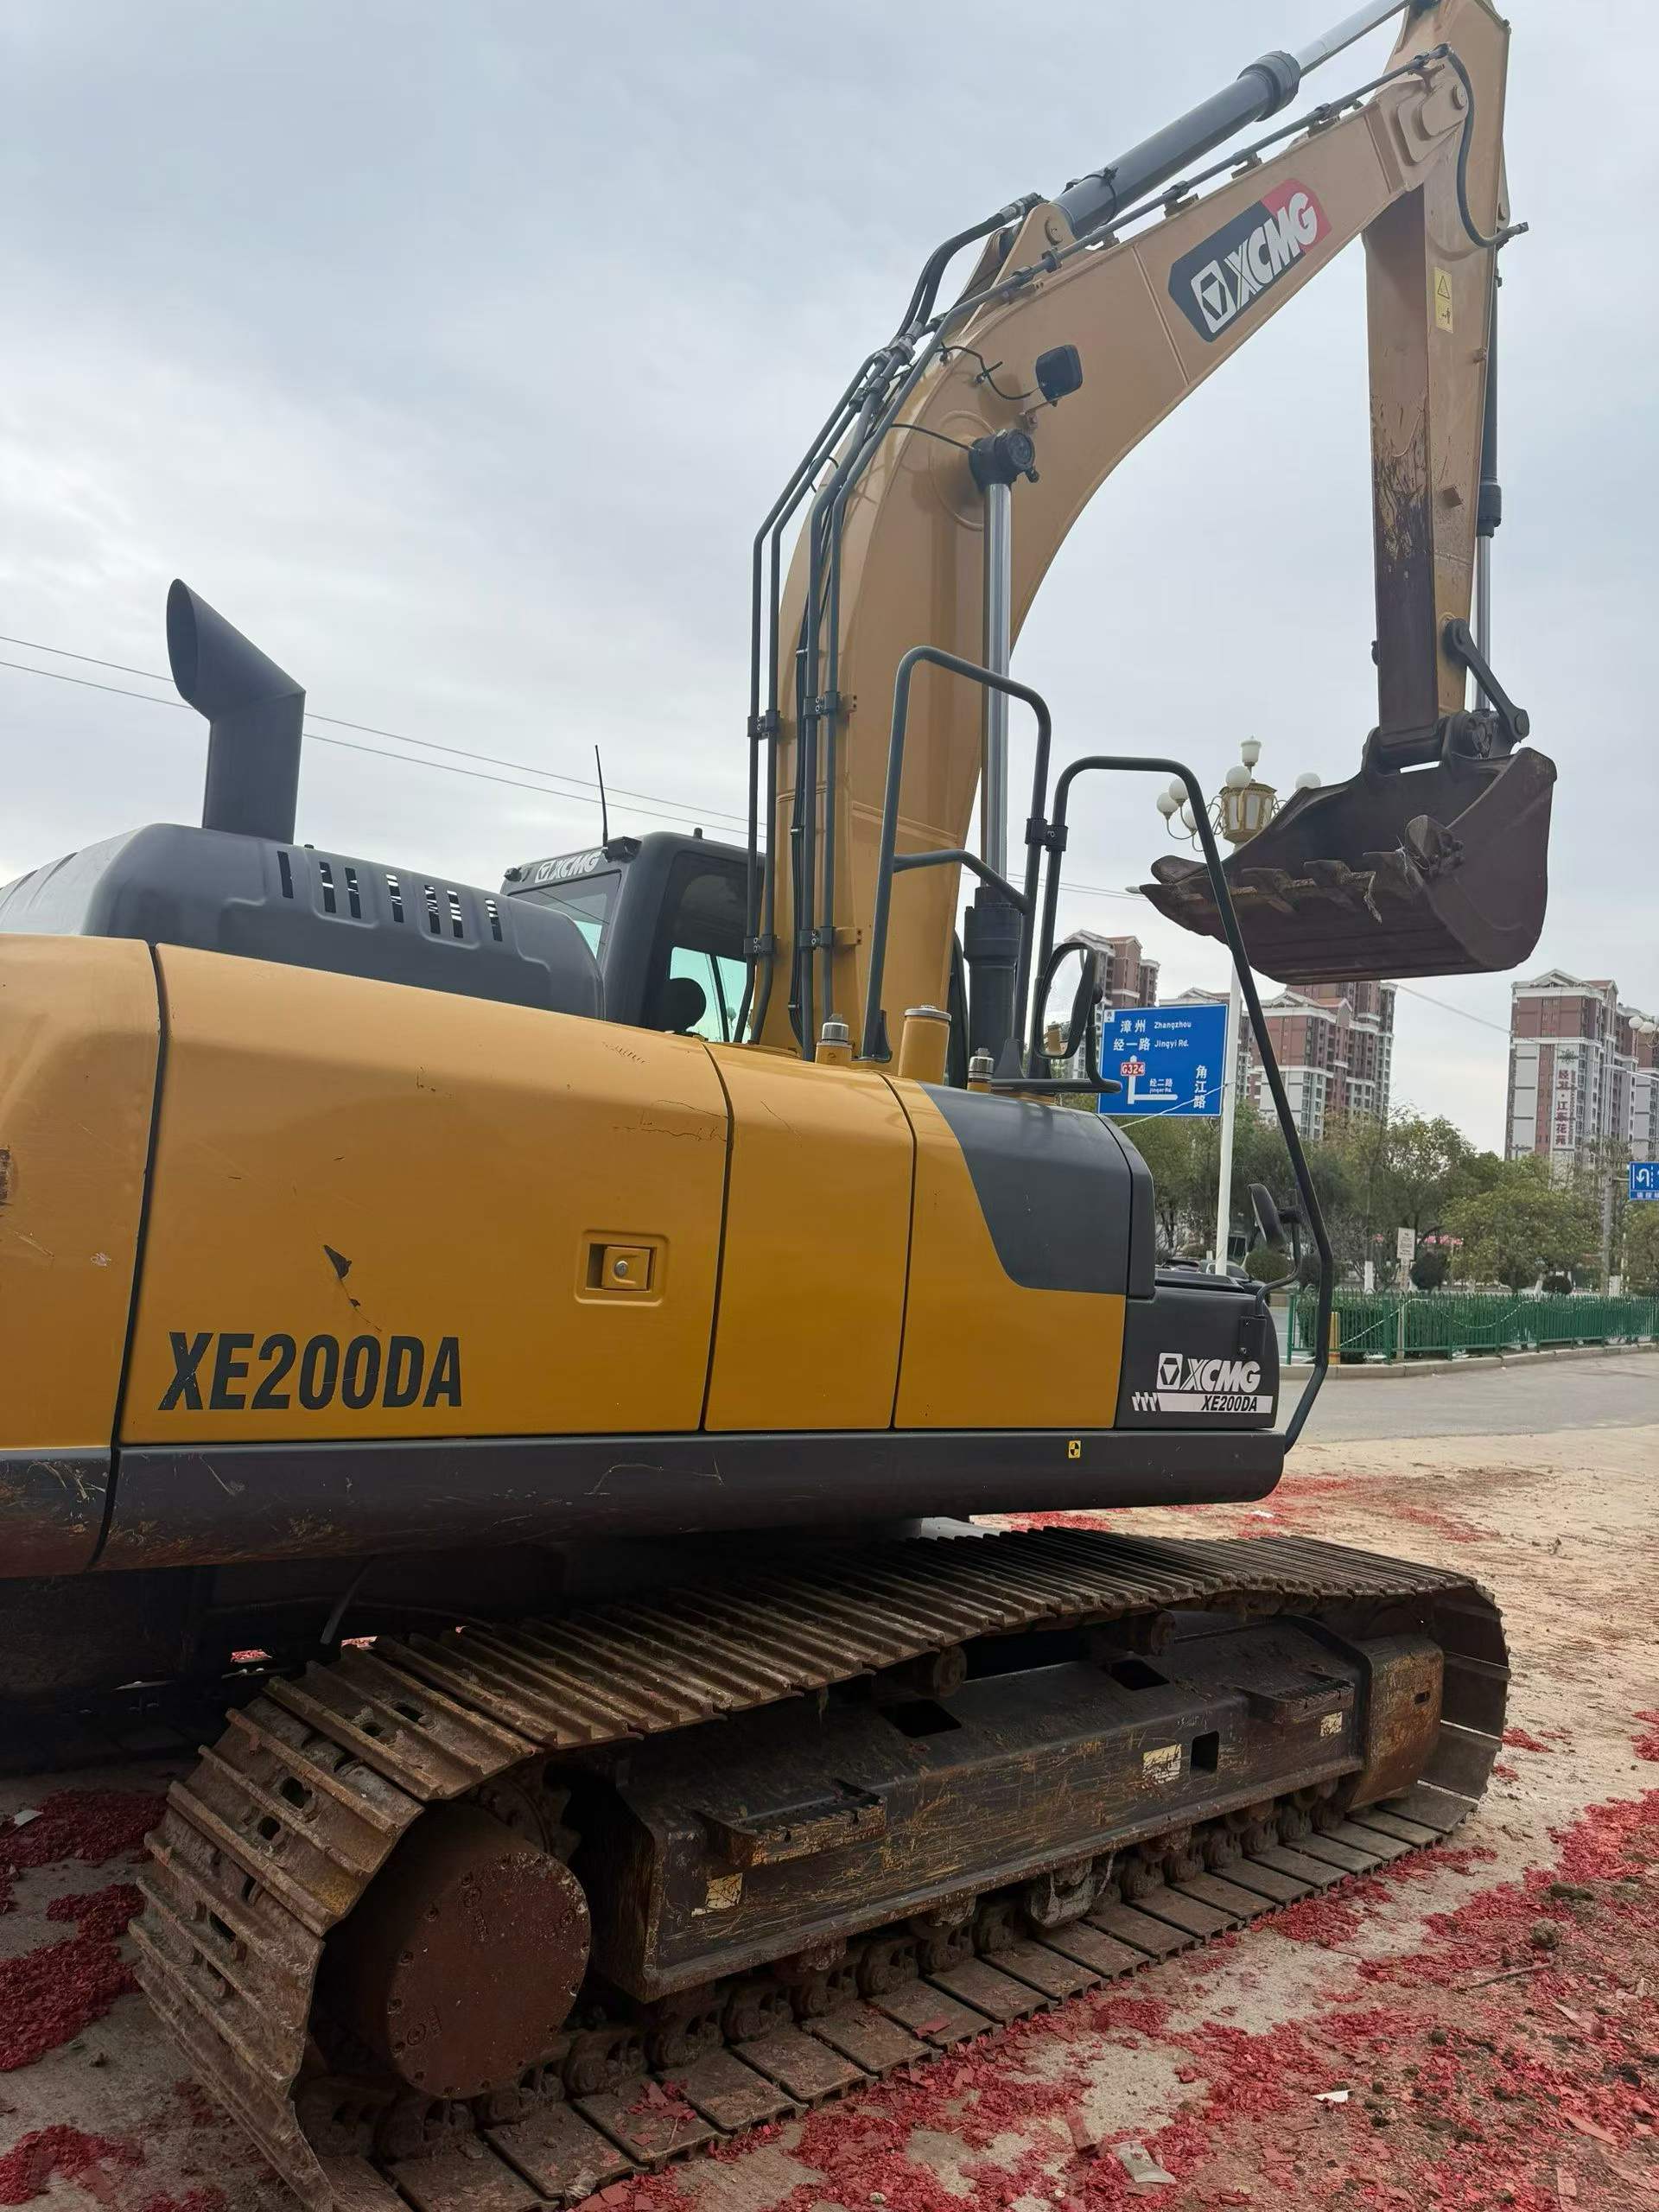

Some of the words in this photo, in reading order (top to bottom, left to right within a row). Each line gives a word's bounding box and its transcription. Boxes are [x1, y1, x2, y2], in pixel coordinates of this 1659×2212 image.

[1224, 192, 1318, 312] XCMG
[550, 852, 601, 880] XCMG
[1120, 1019, 1147, 1033] 漳州
[1154, 1020, 1192, 1031] Zhangzhou
[1113, 1037, 1151, 1052] 经一路
[1154, 1039, 1177, 1049] Jingyi
[1178, 1039, 1189, 1047] Rd.
[1122, 1064, 1144, 1074] G324
[1193, 1065, 1207, 1109] 角江路
[158, 1332, 462, 1411] XE200DA
[1179, 1358, 1261, 1393] XCMG
[1201, 1395, 1258, 1412] XE200DA
